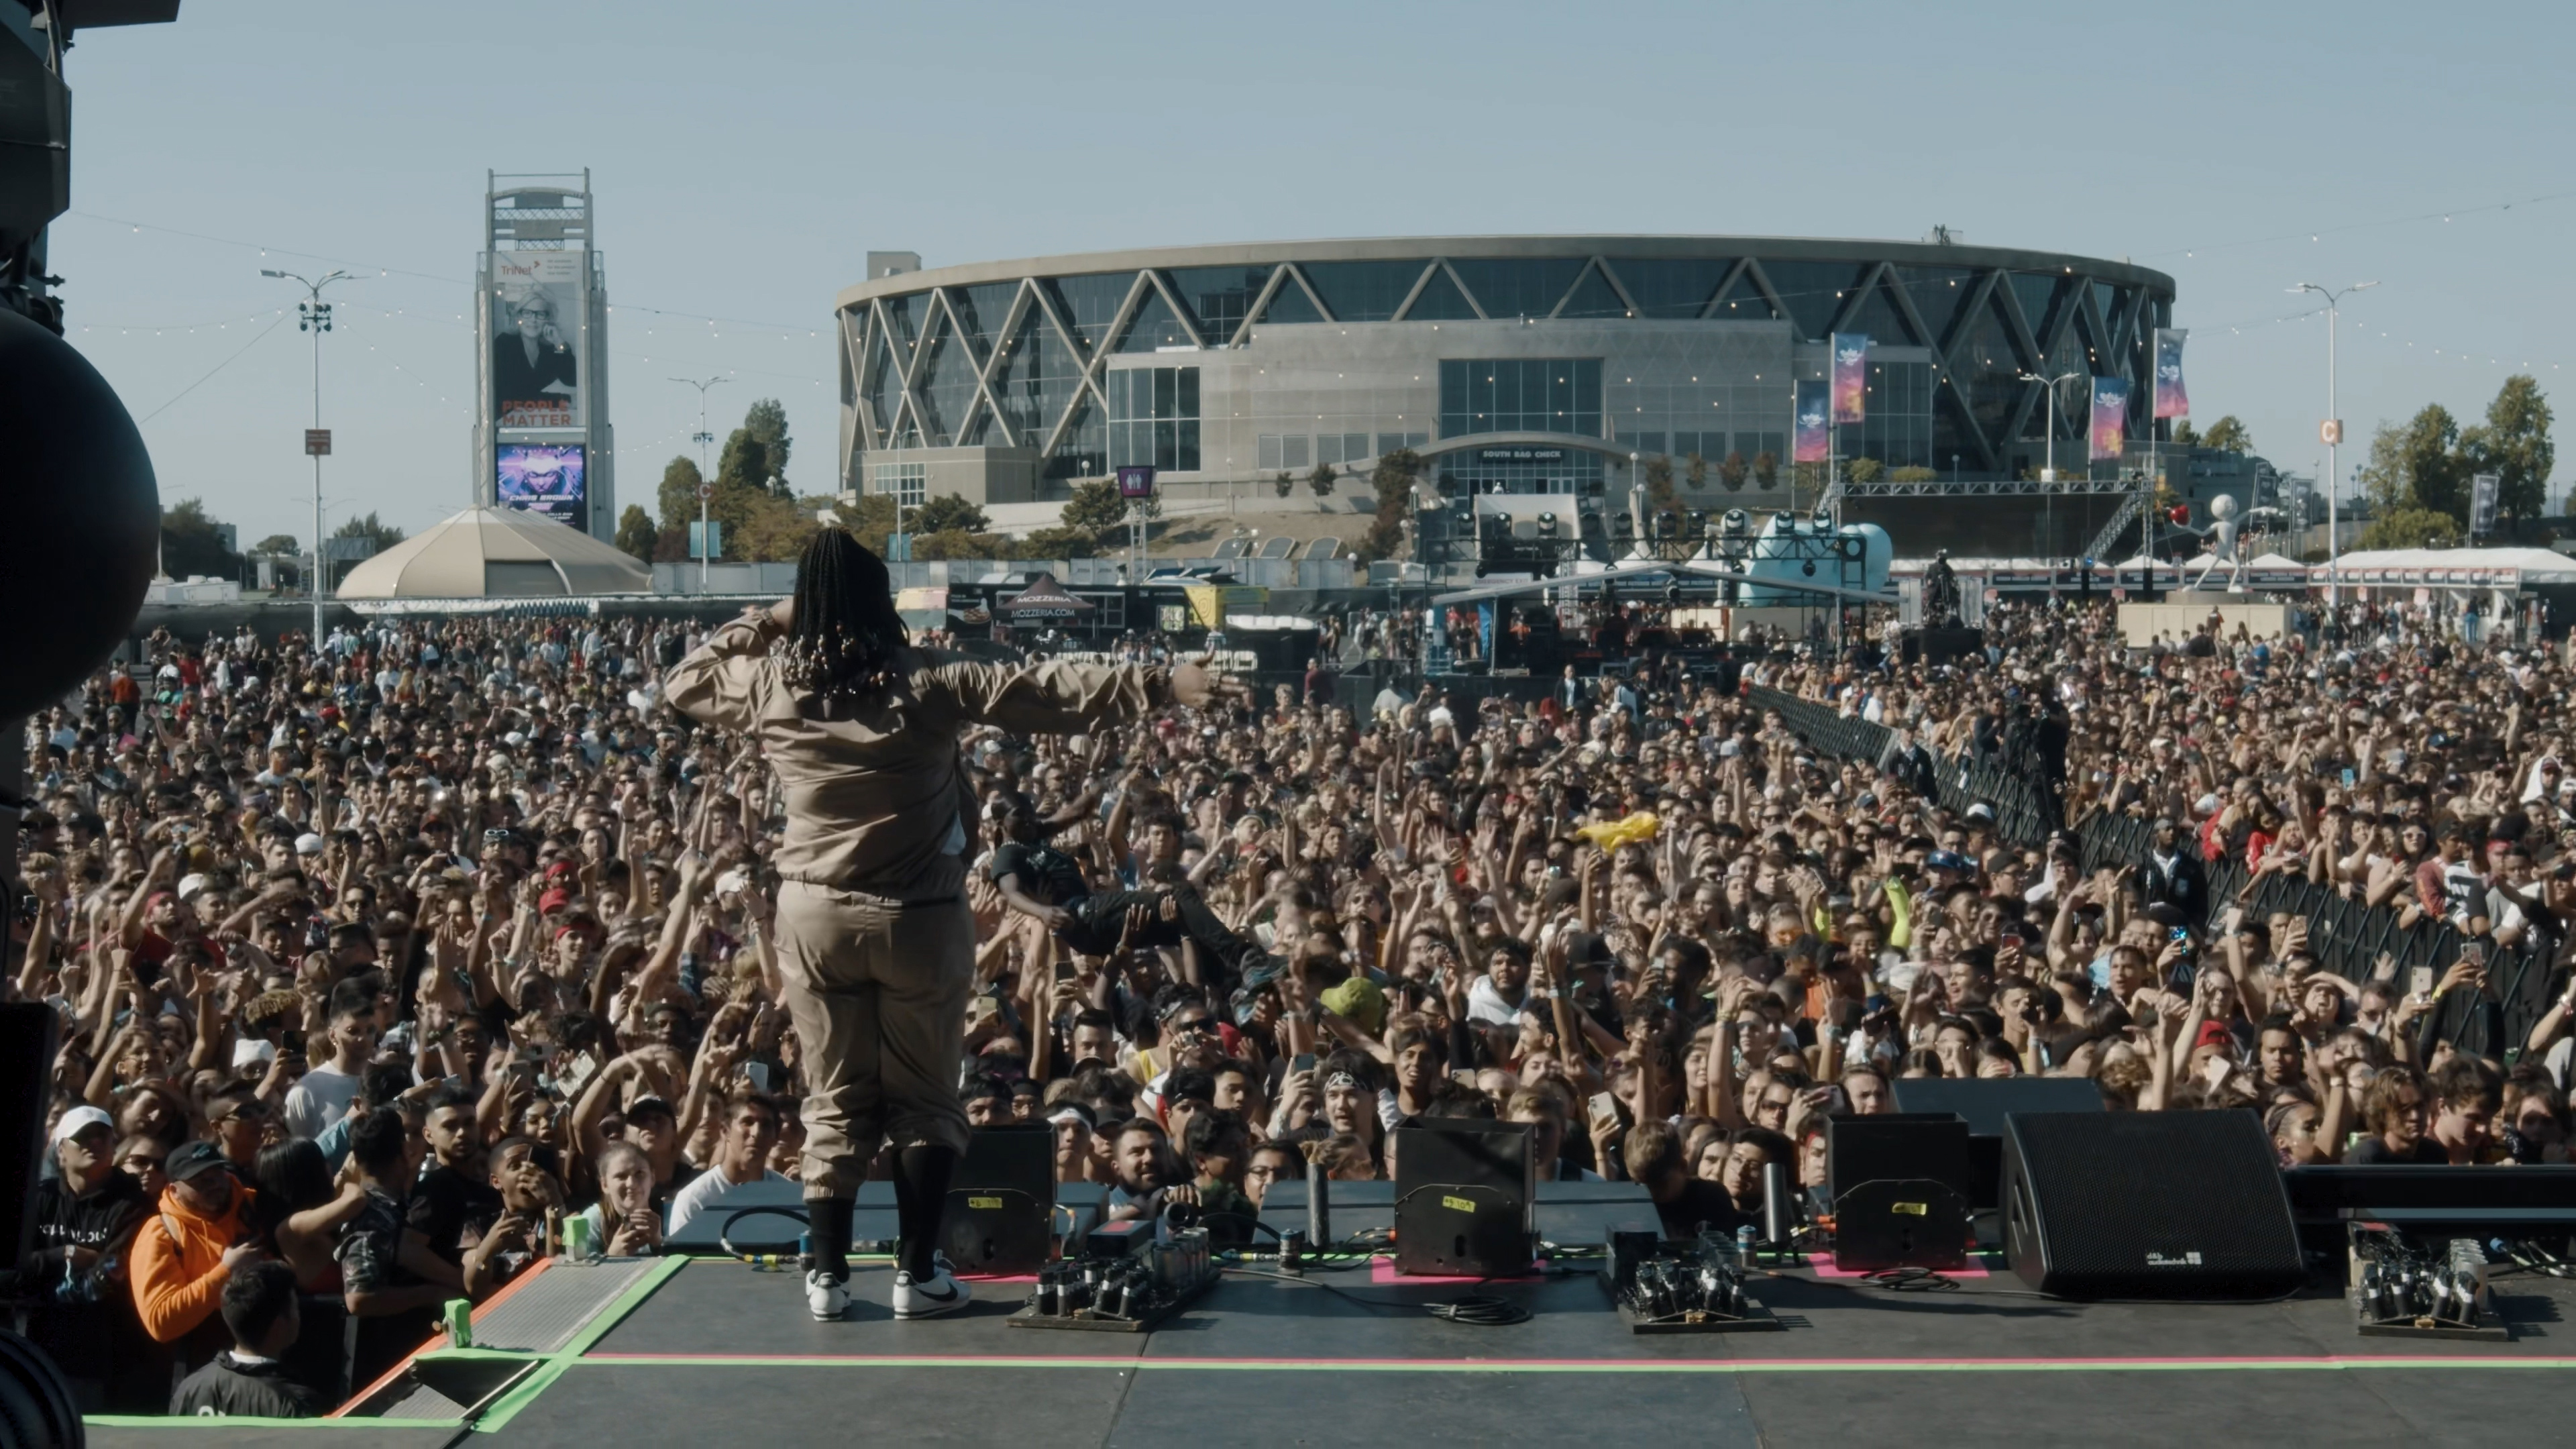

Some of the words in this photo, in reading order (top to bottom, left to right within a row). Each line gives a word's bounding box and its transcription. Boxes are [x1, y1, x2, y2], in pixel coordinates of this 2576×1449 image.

[501, 266, 532, 275] TriNet
[502, 400, 569, 413] PEOPLE
[502, 414, 571, 426] MATTER
[2322, 421, 2335, 442] C
[1017, 595, 1071, 603] MOZZERIA
[1011, 608, 1075, 618] MOZZERIA.COM
